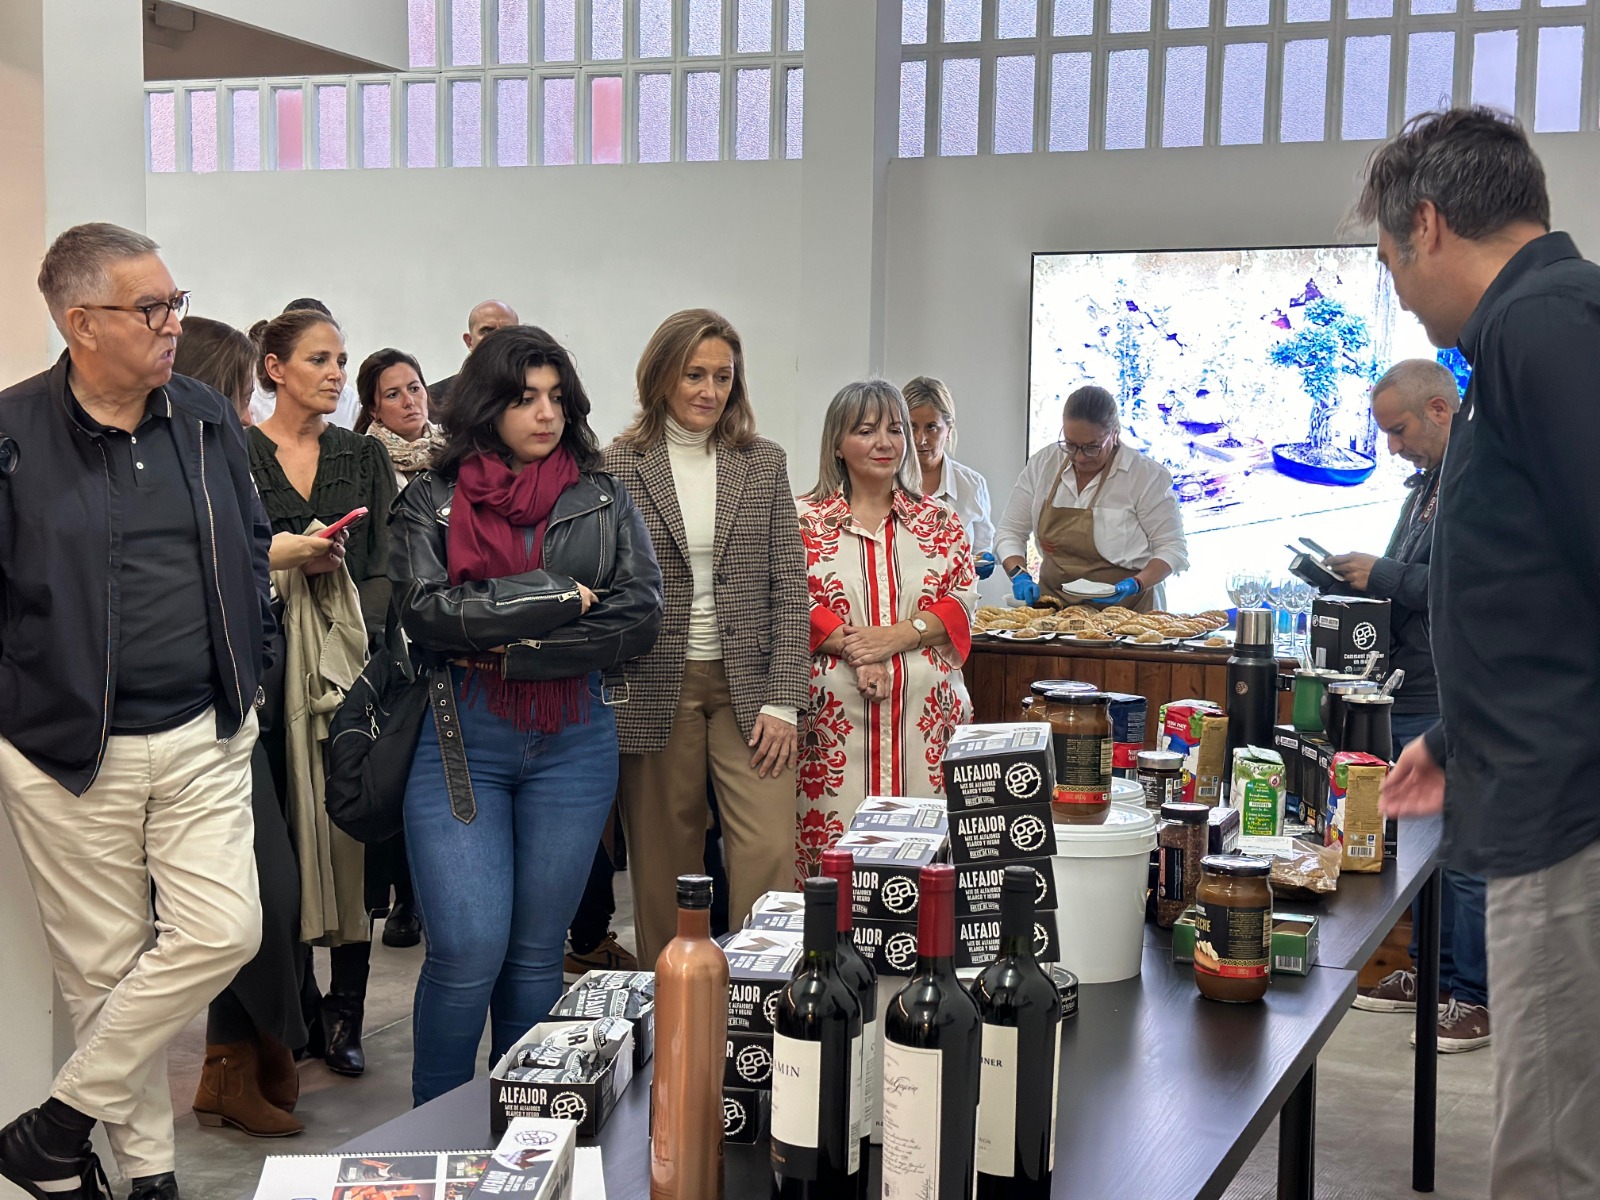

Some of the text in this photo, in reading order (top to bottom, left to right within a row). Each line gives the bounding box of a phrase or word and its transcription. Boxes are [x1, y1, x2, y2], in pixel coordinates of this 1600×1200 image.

[954, 762, 1001, 783] ALFAJOR
[958, 815, 1006, 836] ALFAJOR
[852, 871, 879, 889] AJOR
[852, 927, 882, 946] AJOR
[960, 922, 1001, 940] ALFAJO
[729, 984, 760, 1003] AJOR
[774, 1059, 800, 1078] AMIN
[981, 1057, 1002, 1068] INER
[499, 1086, 547, 1105] ALFAJOR
